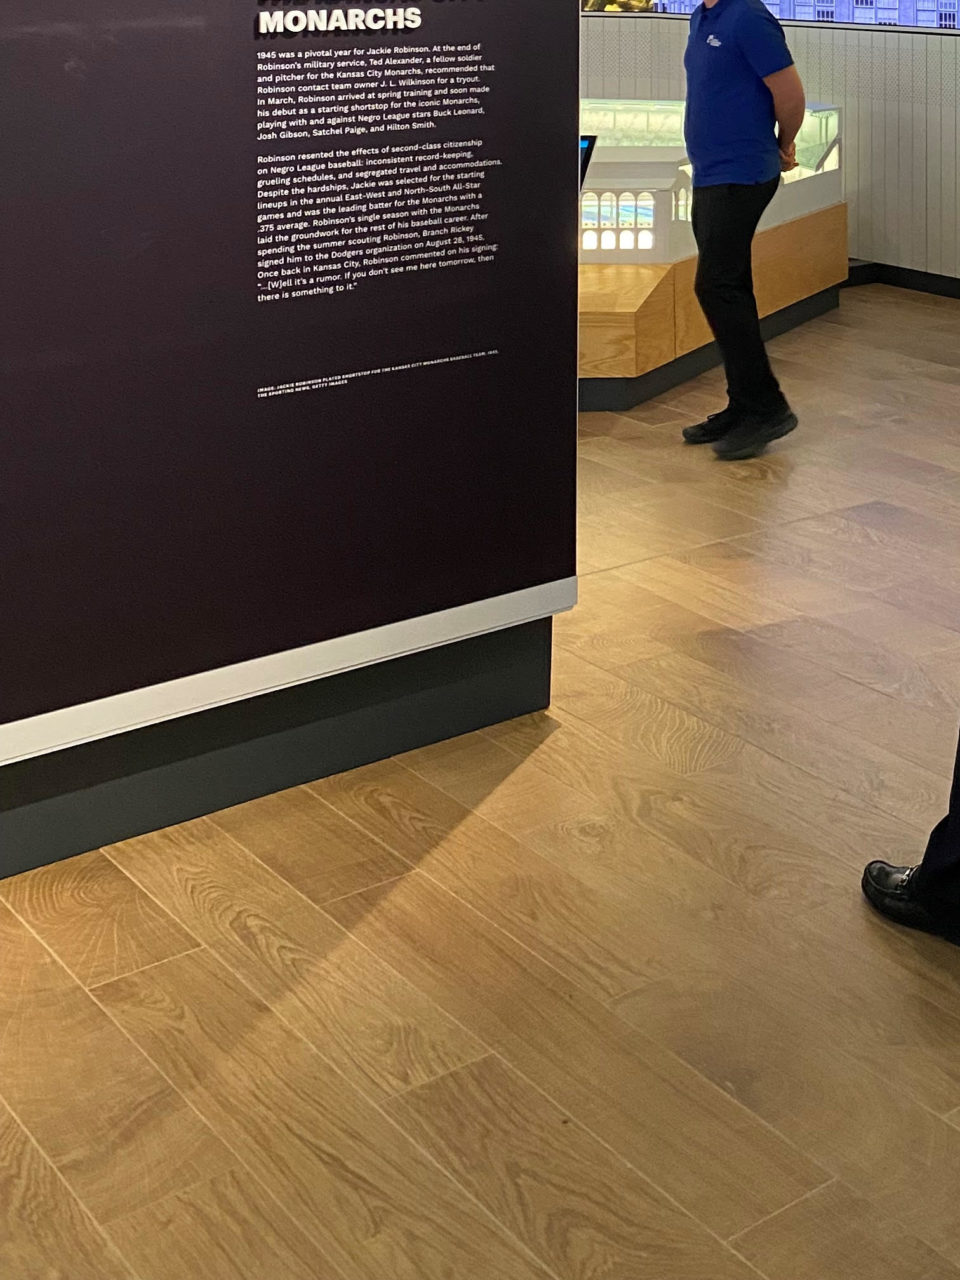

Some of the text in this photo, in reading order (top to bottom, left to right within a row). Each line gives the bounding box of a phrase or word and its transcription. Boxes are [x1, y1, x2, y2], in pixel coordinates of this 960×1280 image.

[259, 7, 422, 34] MONARCHS
[256, 50, 277, 59] 1945
[304, 48, 333, 59] pivotal
[333, 49, 352, 58] year
[353, 47, 365, 55] for
[366, 47, 392, 55] Jackie
[442, 44, 455, 52] the
[456, 43, 471, 51] end
[472, 42, 481, 51] of
[303, 60, 335, 69] military
[368, 57, 383, 66] Ted
[432, 55, 456, 63] fellow
[457, 54, 482, 62] soldier
[256, 73, 273, 83] and
[274, 73, 305, 83] pitcher
[306, 71, 319, 80] for
[320, 71, 334, 79] the
[366, 69, 383, 78] City
[424, 64, 478, 74] recommended
[257, 85, 296, 94] Robinson
[297, 83, 329, 92] contact
[353, 81, 379, 89] owner
[398, 78, 435, 86] Wilkinson
[436, 76, 448, 84] for
[256, 98, 266, 106] In
[297, 94, 336, 103] Robinson
[337, 91, 365, 101] arrived
[377, 90, 402, 100] spring
[403, 88, 432, 97] training
[433, 87, 448, 95] and
[469, 85, 490, 93] made
[256, 109, 270, 117] his
[271, 107, 297, 116] debut
[317, 104, 349, 114] starting
[350, 102, 389, 111] shortstop
[390, 100, 402, 109] for
[403, 100, 417, 108] the
[418, 99, 441, 107] iconic
[256, 120, 287, 131] playing
[288, 118, 307, 127] with
[309, 116, 325, 125] and
[326, 115, 356, 126] against
[357, 114, 381, 123] Negro
[382, 112, 410, 121] League
[432, 108, 452, 117] Buck
[256, 131, 277, 141] Josh
[312, 126, 343, 137] Satchel
[369, 123, 385, 132] and
[386, 123, 410, 131] Hilton
[257, 139, 483, 164] Robinson resented the effects of second-class citizenship
[270, 166, 295, 175] Negro
[296, 163, 326, 172] League
[365, 155, 413, 165] inconsistent
[256, 177, 291, 189] grueling
[337, 170, 353, 179] and
[355, 166, 397, 179] segregated
[398, 164, 421, 174] travel
[422, 163, 437, 172] and
[257, 189, 289, 198] Despite
[290, 186, 305, 195] the
[350, 180, 376, 190] Jackie
[377, 179, 394, 187] was
[395, 174, 428, 185] selected
[429, 174, 441, 182] for
[442, 173, 455, 181] the
[456, 170, 485, 180] starting
[257, 293, 280, 302] there
[291, 285, 334, 297] something
[335, 284, 345, 292] to
